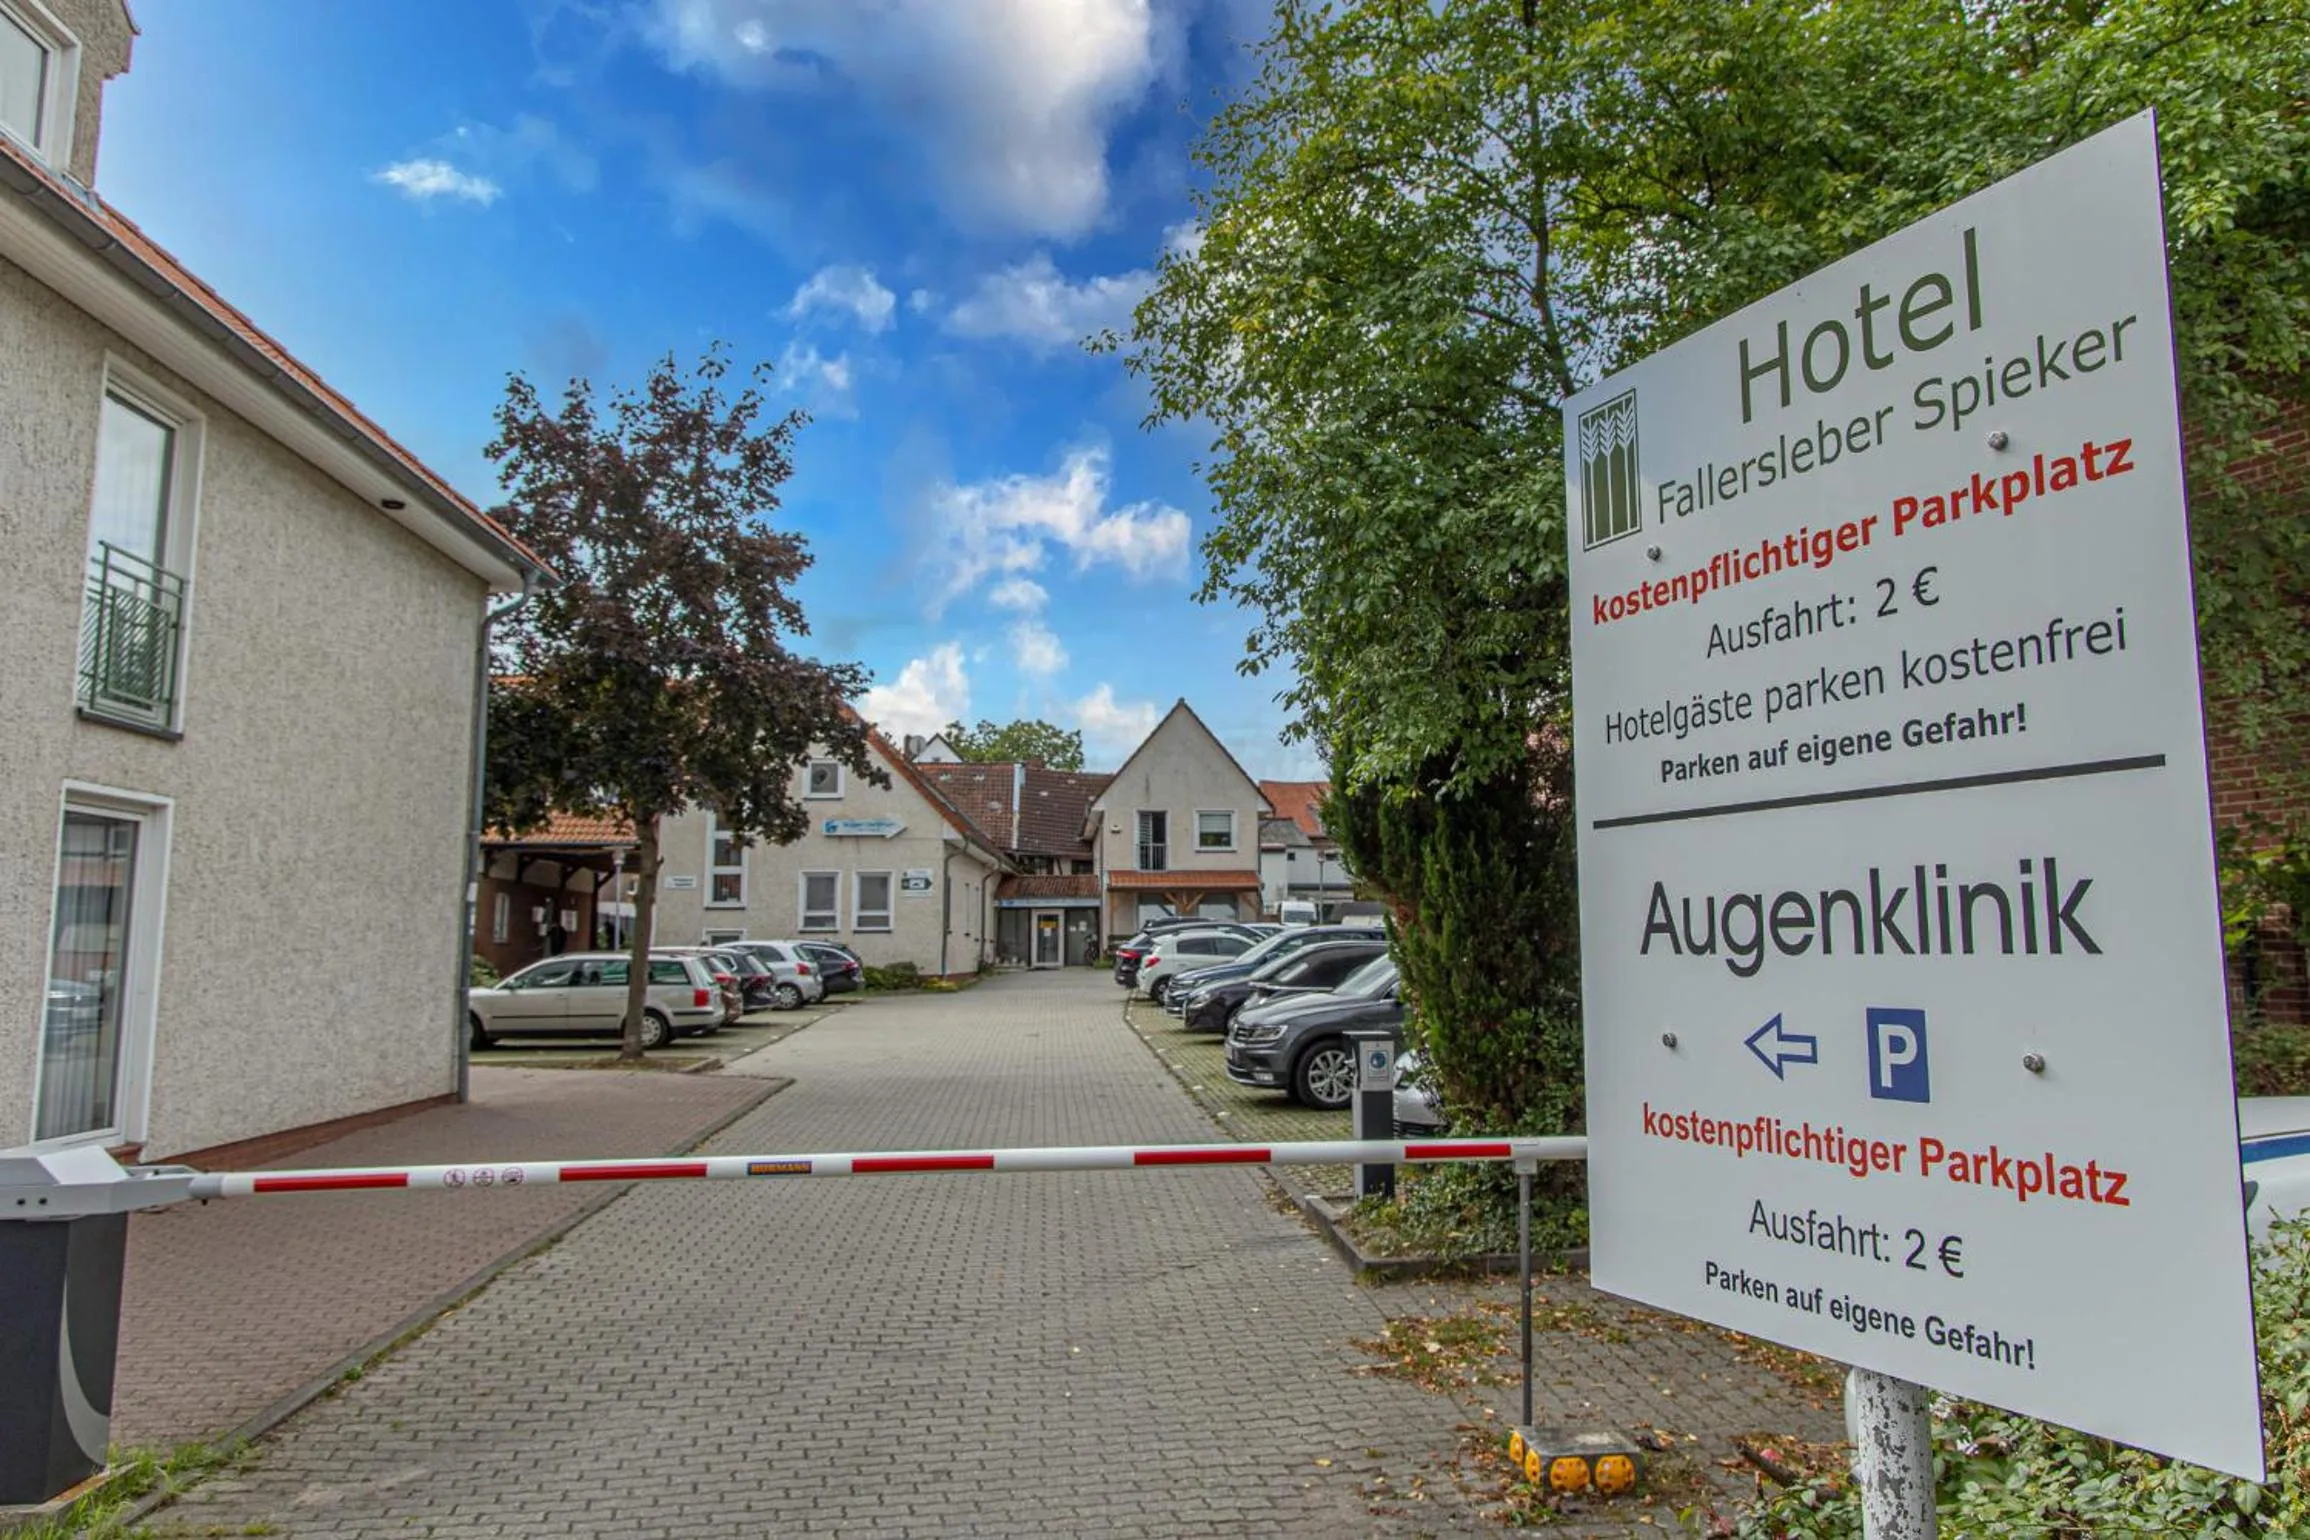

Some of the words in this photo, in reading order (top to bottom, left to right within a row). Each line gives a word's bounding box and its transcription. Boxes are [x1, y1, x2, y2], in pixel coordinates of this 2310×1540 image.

[1738, 226, 1983, 425] Hotel
[1657, 405, 1894, 525] Fallersleber
[1913, 314, 2137, 432] Spieker
[1593, 514, 1879, 626] kostenpflichtiger
[1892, 438, 2135, 537] Parkplatz
[1706, 593, 1857, 660] Ausfahrt:
[1875, 577, 1899, 619] 2
[1911, 565, 1940, 607] €
[1605, 689, 1753, 745] Hotelgäste
[1765, 665, 1885, 725] parken
[1901, 606, 2127, 690] kostenfrei
[1660, 752, 1740, 784] Parken
[1747, 738, 1789, 771] auf
[1796, 729, 1893, 767] eigene
[1901, 701, 2027, 748] Gefahr!
[1639, 856, 2104, 979] Augenklinik
[1876, 1023, 1918, 1088] P
[1643, 1101, 1908, 1179] kostenpflichtiger
[1919, 1136, 2131, 1208] Parkplatz
[1748, 1198, 1891, 1264] Ausfahrt:
[1904, 1227, 1928, 1272] 2
[1937, 1234, 1965, 1279] €
[1705, 1260, 1779, 1304] Parken
[1785, 1286, 1824, 1315] auf
[1829, 1294, 1916, 1339] eigene
[1924, 1315, 2036, 1371] Gefahr!
